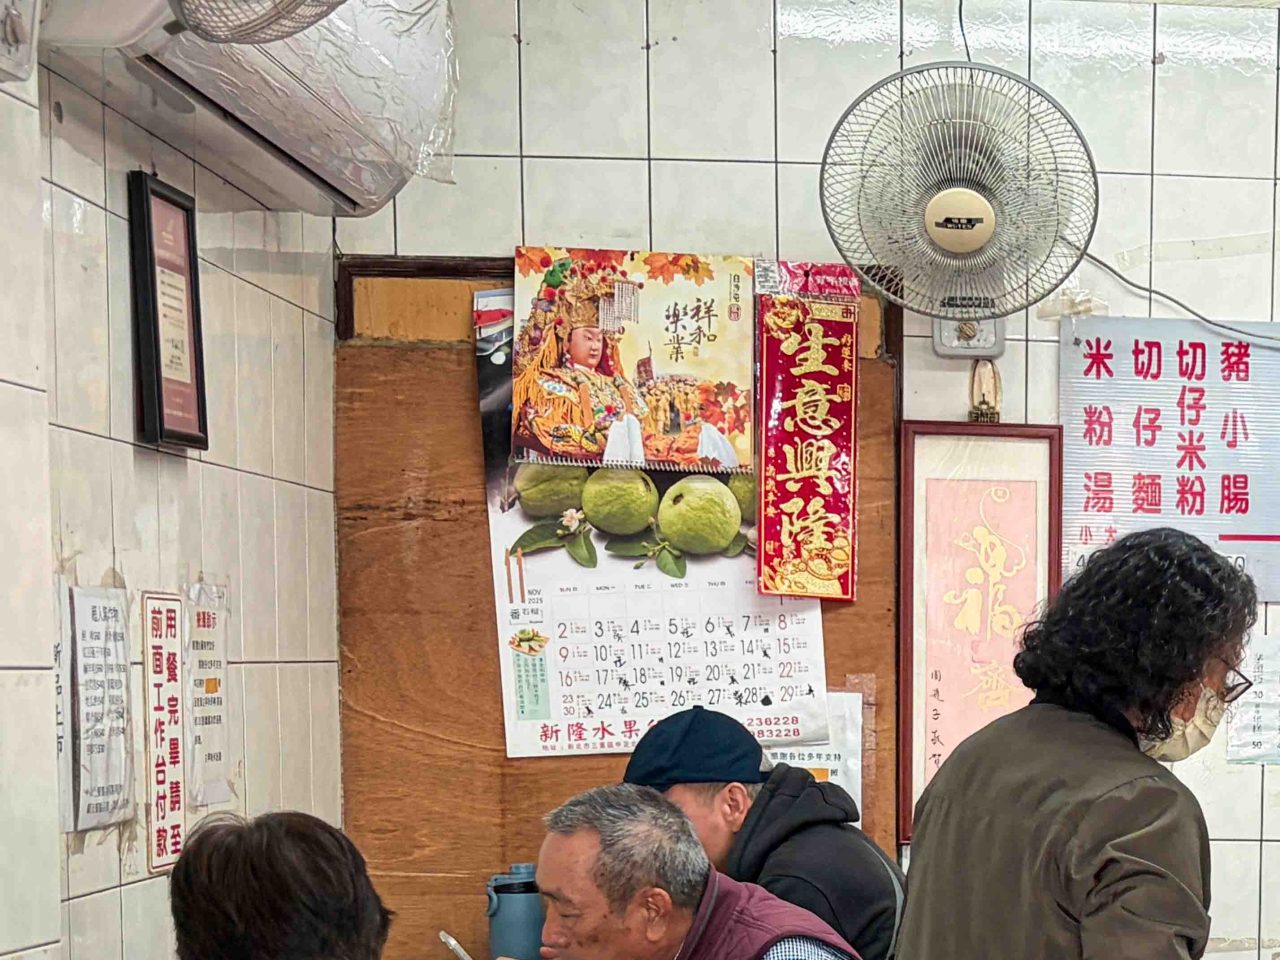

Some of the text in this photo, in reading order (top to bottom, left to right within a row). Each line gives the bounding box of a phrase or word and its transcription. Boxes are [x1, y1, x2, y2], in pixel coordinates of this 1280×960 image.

[663, 301, 693, 363] 樂業
[689, 297, 719, 346] 祥和
[776, 323, 842, 551] 生意興隆
[1082, 337, 1114, 514] 米粉湯
[1132, 339, 1162, 515] 切仔麵
[1176, 339, 1207, 516] 切仔米粉
[1220, 341, 1251, 515] 豬小腸
[557, 613, 788, 639] 2 3 4 5 6 7 8
[558, 637, 791, 663] 9 10 11 12 13 14 15
[558, 661, 793, 687] 16 17 18 19 20 21 22
[562, 685, 795, 710] 23 24 25 26 27 28 29
[151, 606, 169, 858] 前面工作台付款
[164, 608, 183, 855] 用餐完畢請至
[563, 706, 576, 716] 30
[1252, 741, 1263, 750] 50
